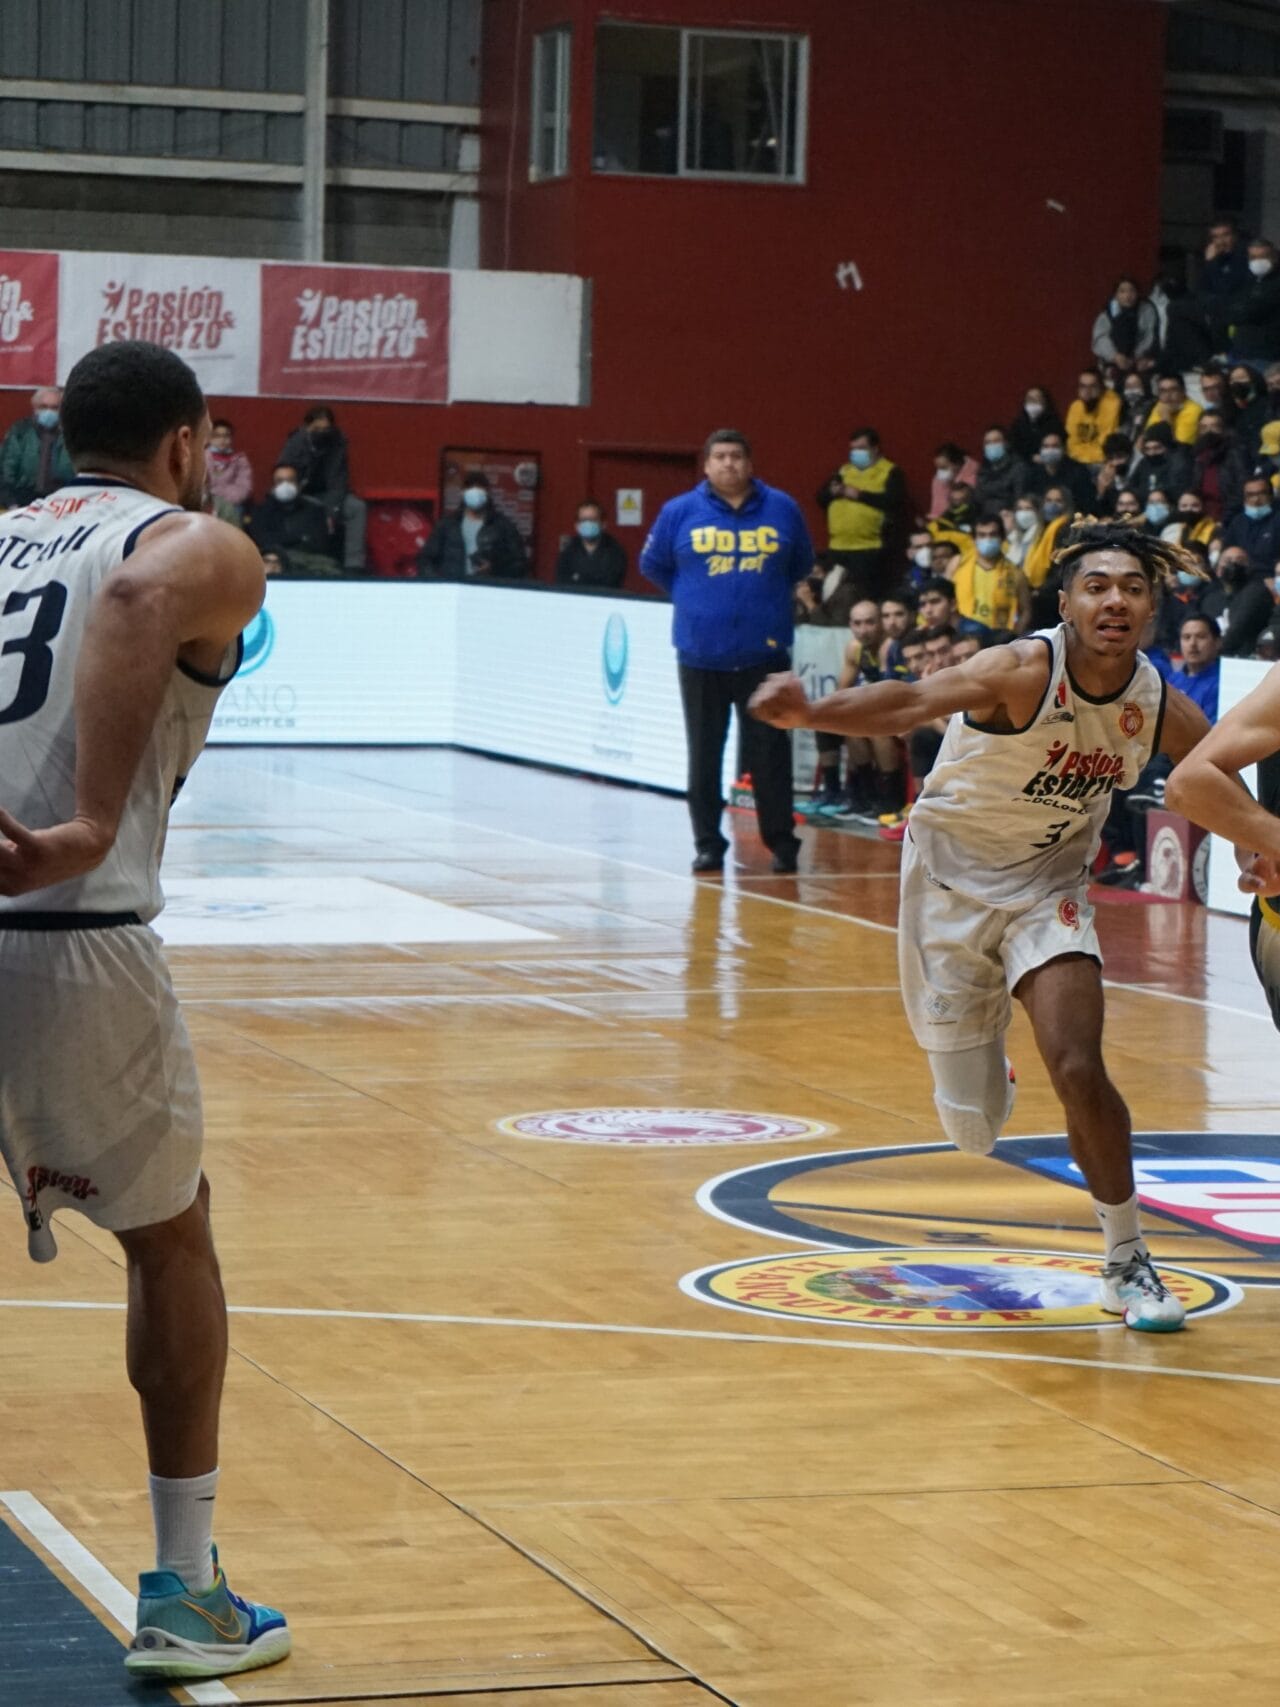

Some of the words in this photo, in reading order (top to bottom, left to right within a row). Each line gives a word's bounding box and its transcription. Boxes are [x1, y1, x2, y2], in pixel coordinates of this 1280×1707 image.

[125, 285, 224, 320] Pasión
[321, 293, 417, 330] Pasión
[289, 325, 416, 360] Esfuerzo
[690, 526, 779, 553] UDEC
[219, 683, 297, 714] ANO
[213, 716, 296, 729] SPORTES
[1029, 820, 1071, 849] 3
[735, 1260, 1045, 1322] LLANQUIHUE
